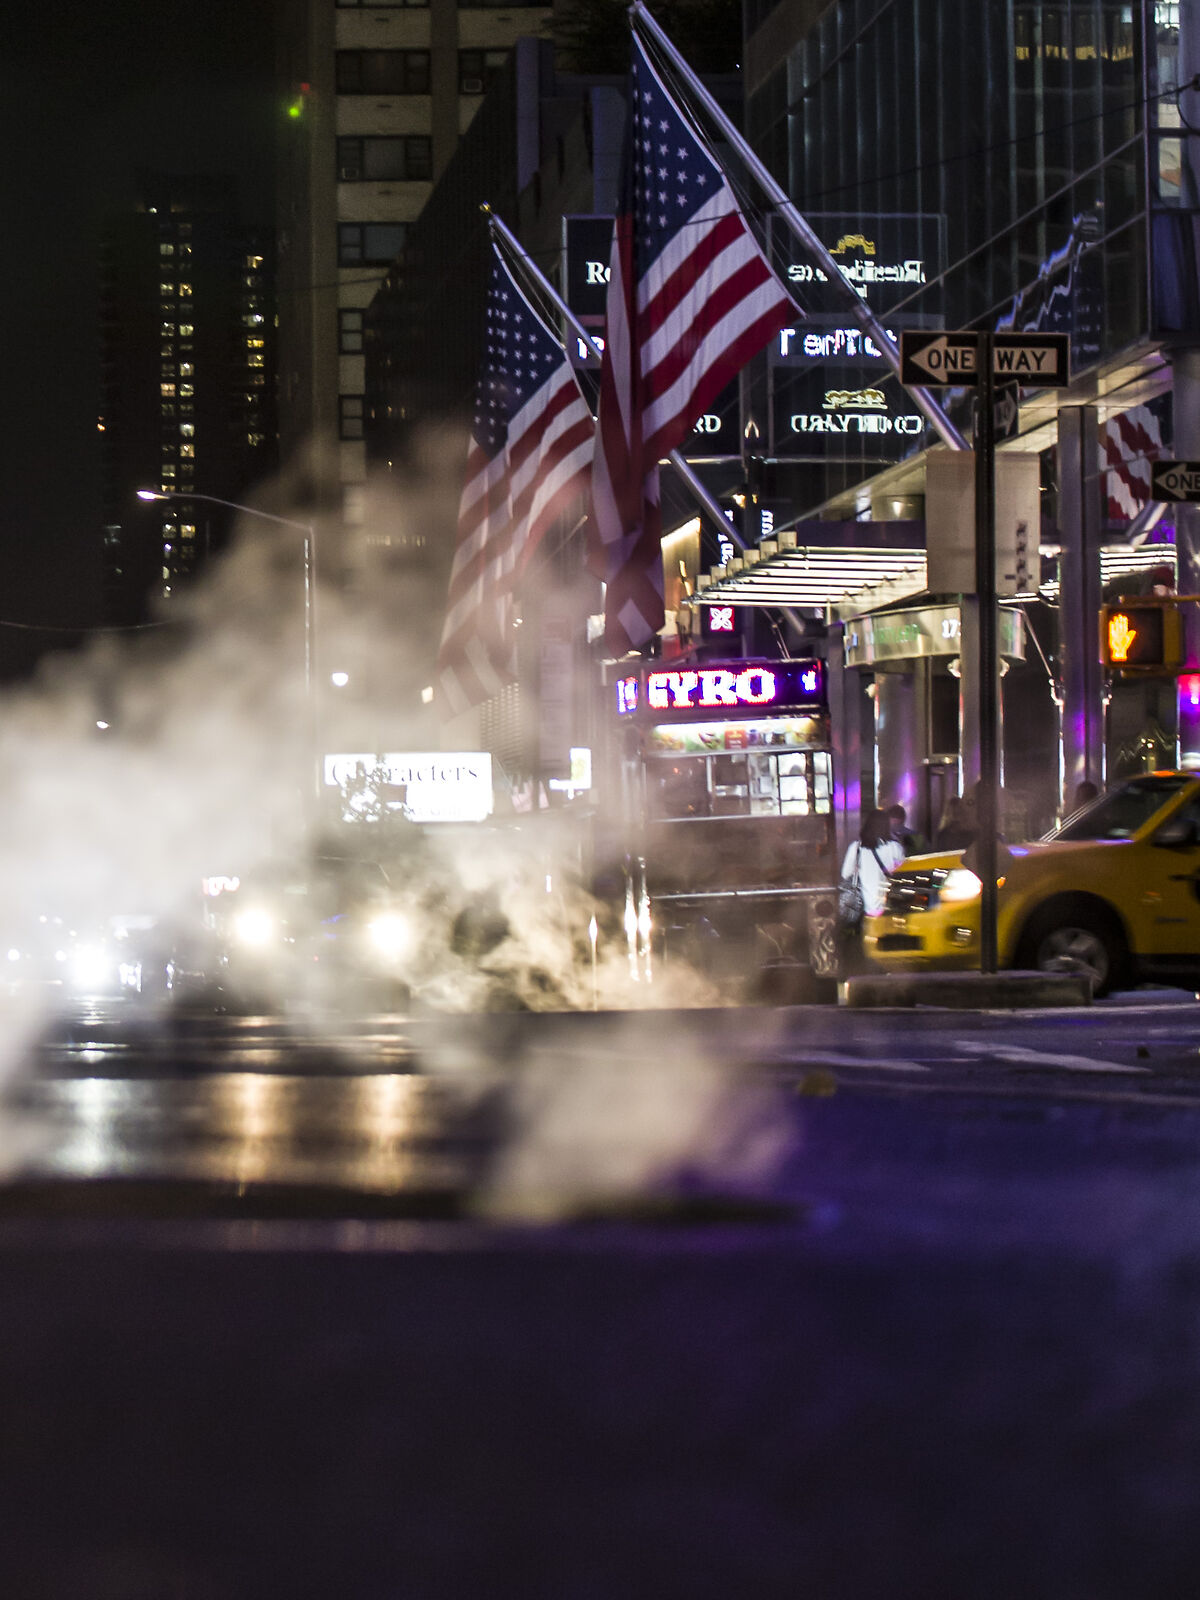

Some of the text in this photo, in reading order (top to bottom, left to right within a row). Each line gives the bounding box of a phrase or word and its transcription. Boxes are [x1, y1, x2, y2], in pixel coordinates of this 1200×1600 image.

[927, 349, 1047, 371] ONE WAY
[941, 618, 961, 639] 17
[648, 668, 777, 709] GYRO
